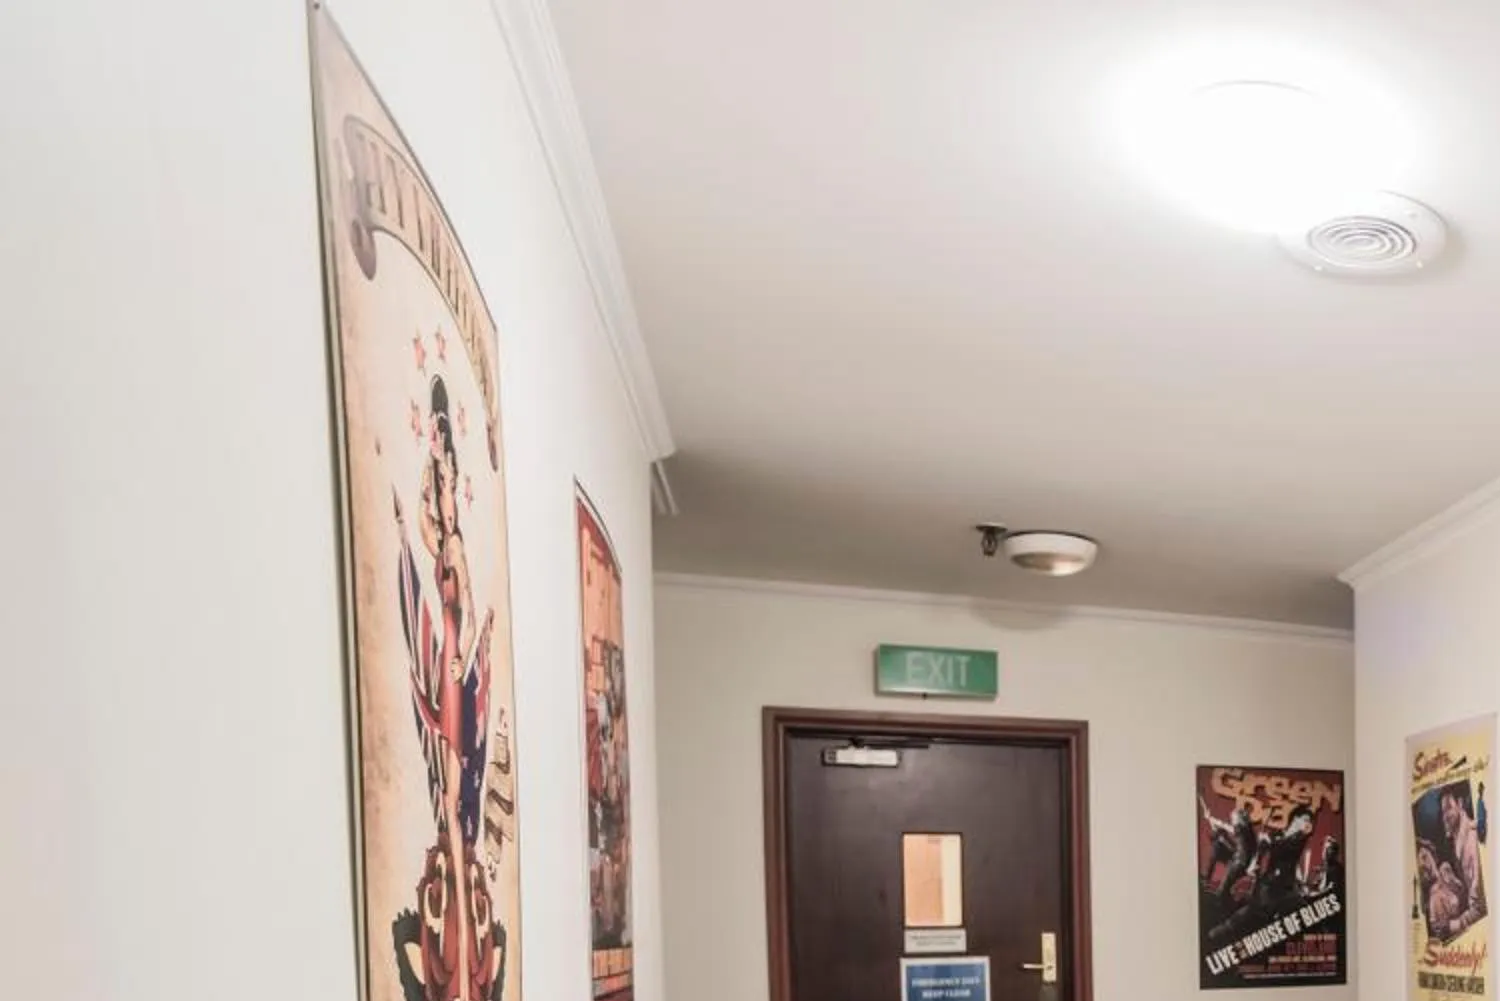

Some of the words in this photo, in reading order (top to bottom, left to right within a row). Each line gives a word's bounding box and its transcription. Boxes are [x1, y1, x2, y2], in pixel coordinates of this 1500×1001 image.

[906, 651, 972, 688] EXIT
[1205, 944, 1240, 976] LIVE
[1242, 920, 1288, 957] HOUSE
[1283, 911, 1302, 936] OF
[1299, 893, 1341, 928] BLUES
